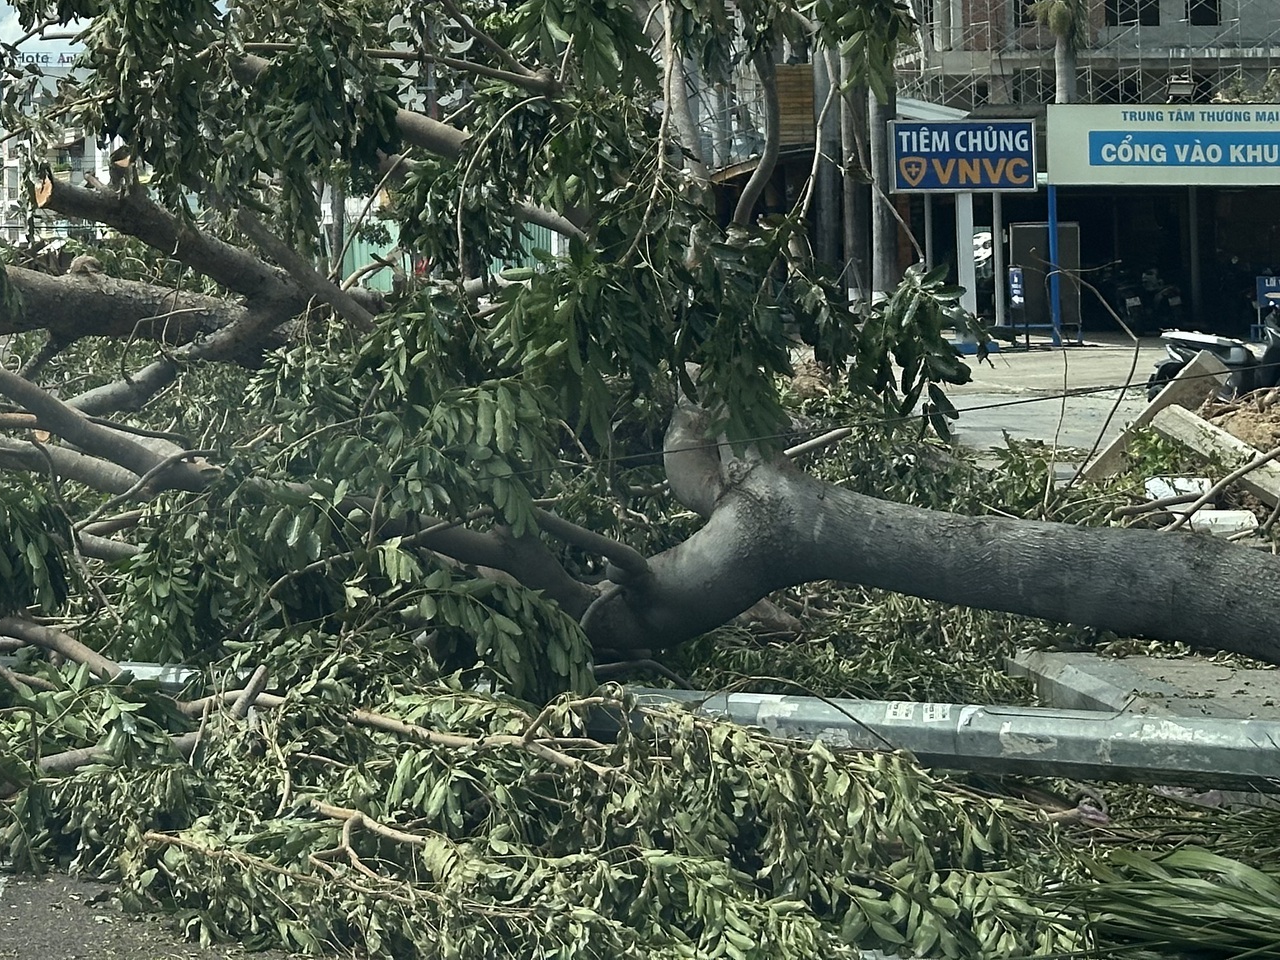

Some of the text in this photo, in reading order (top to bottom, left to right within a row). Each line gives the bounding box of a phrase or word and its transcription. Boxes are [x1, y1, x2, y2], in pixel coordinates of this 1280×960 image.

[1121, 108, 1280, 124] TRUNG TÂM THƯƠNG MẠI
[898, 124, 1029, 153] TIÊM CHỦNG
[1101, 134, 1279, 163] CỔNG VÀO KHU
[932, 157, 1029, 185] VNVC
